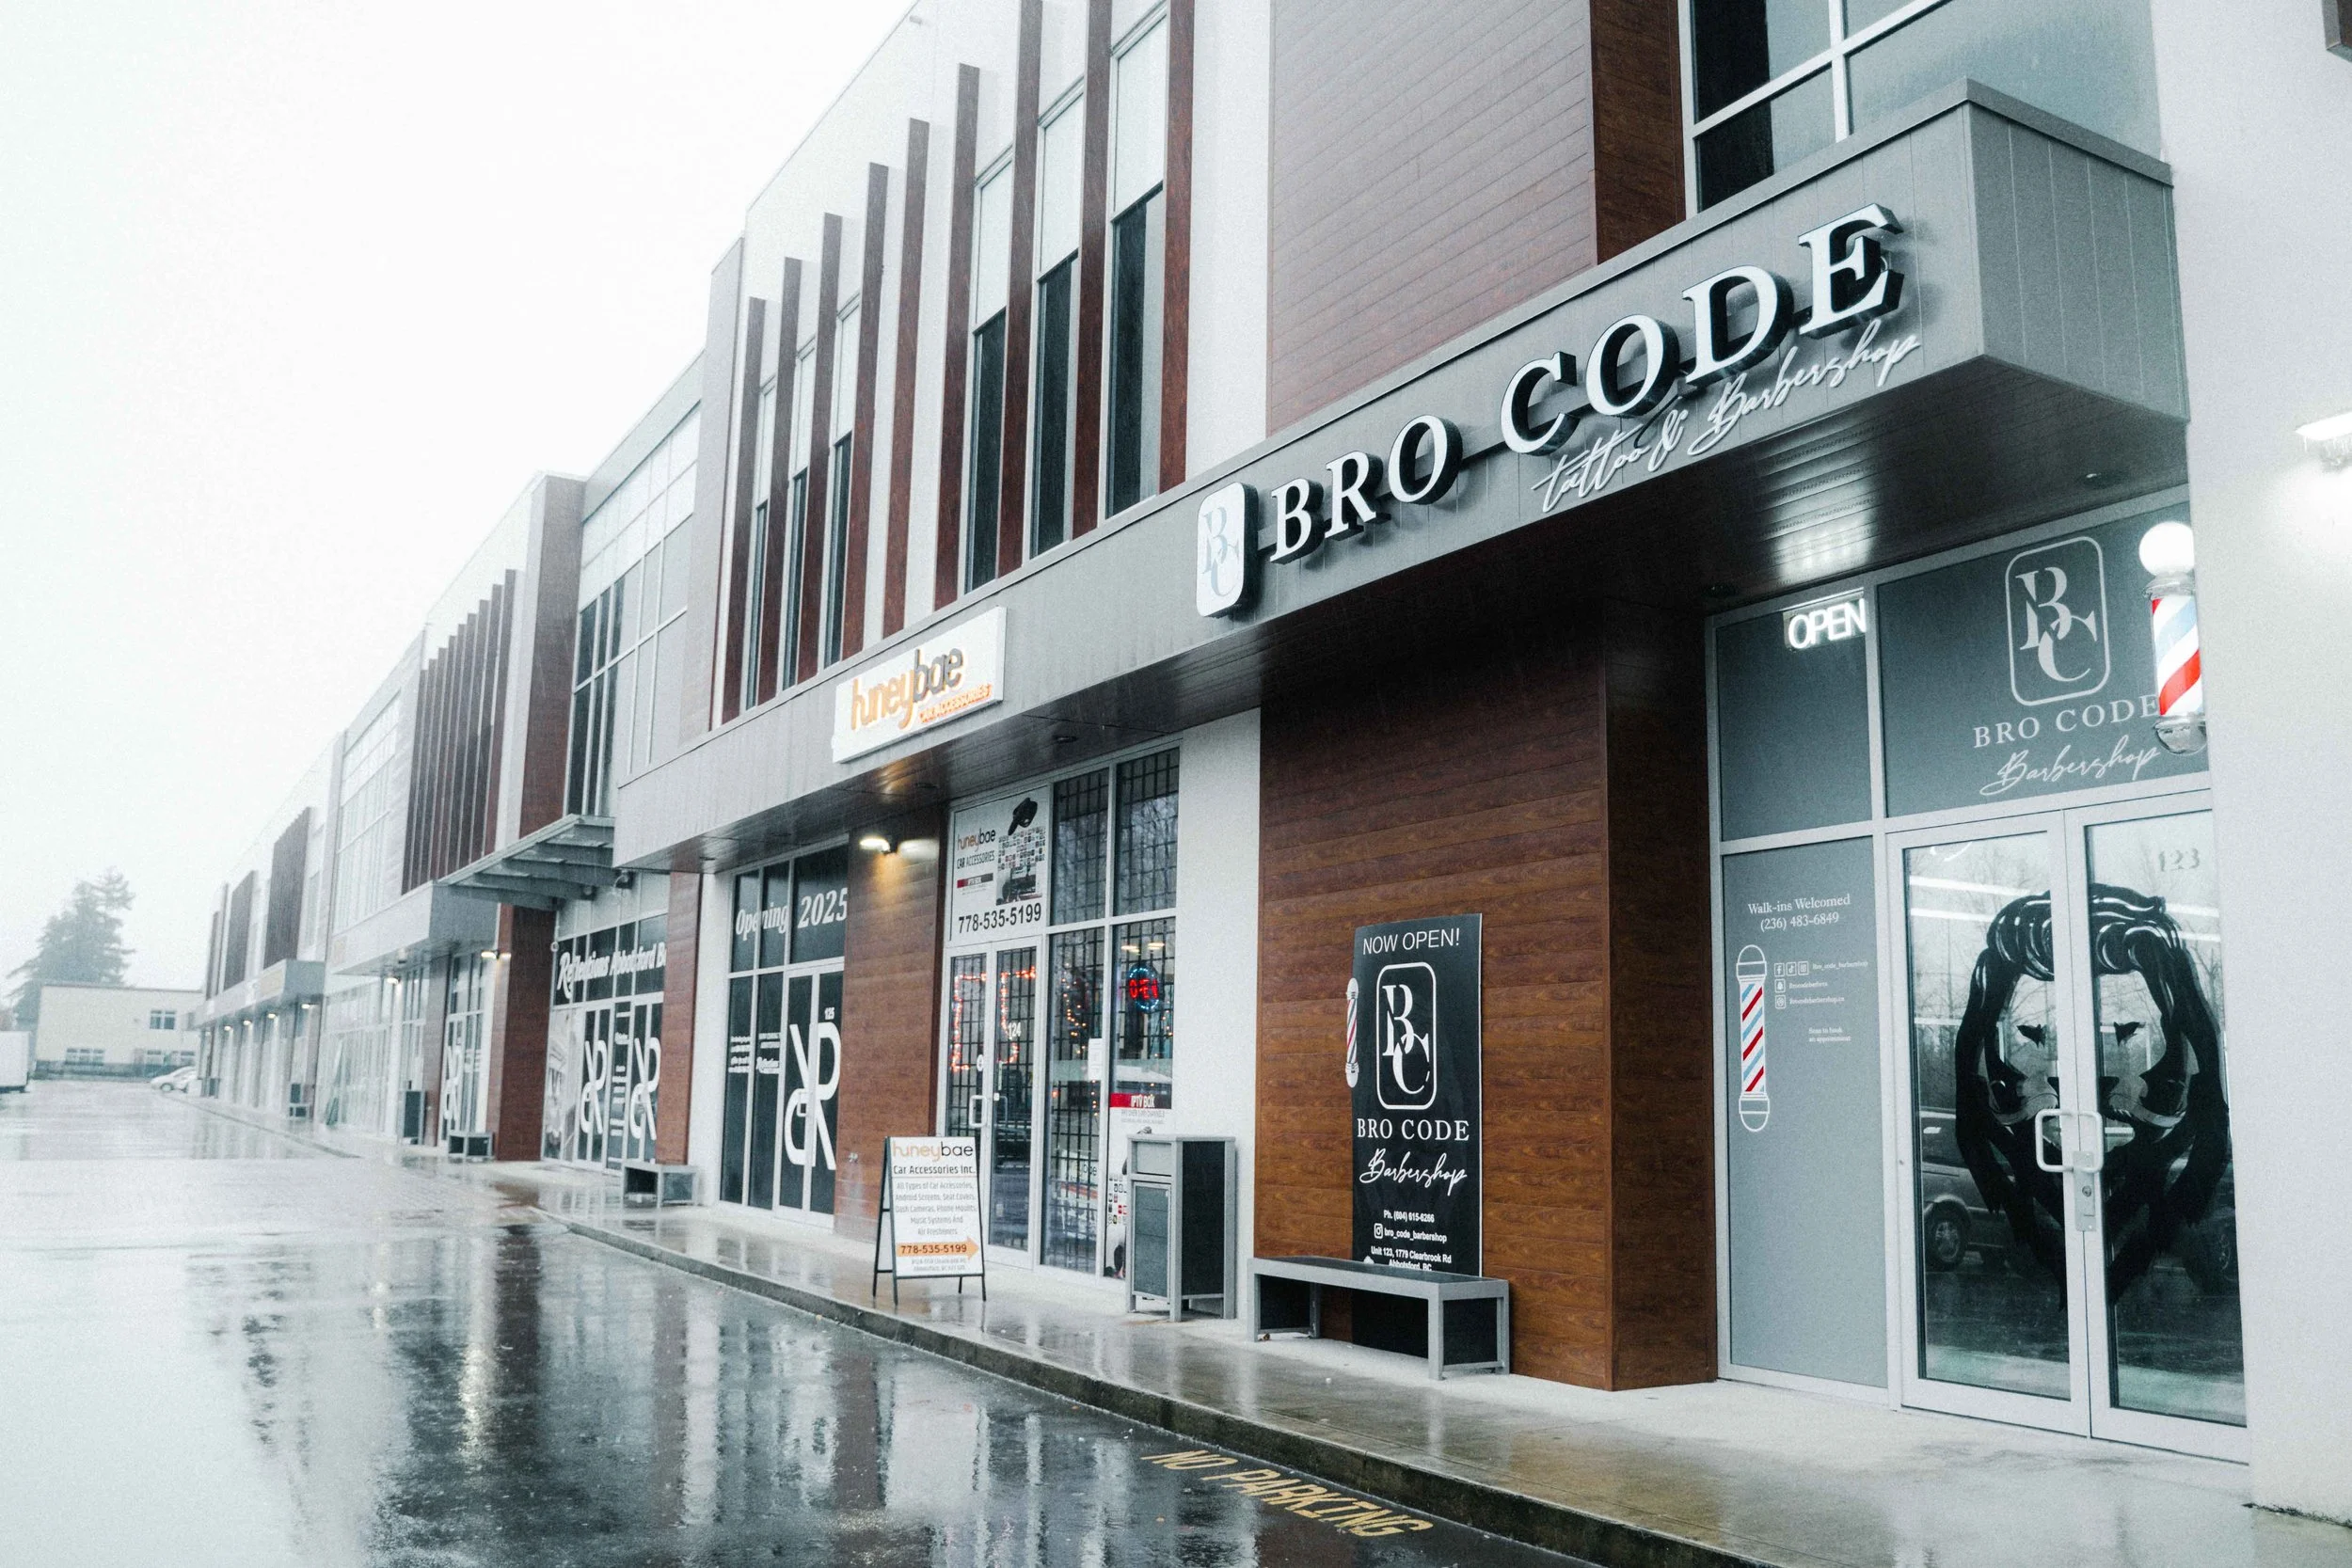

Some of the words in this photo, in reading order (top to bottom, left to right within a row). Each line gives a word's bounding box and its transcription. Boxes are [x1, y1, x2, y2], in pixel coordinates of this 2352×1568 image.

[1270, 414, 1458, 564] BRO
[1501, 203, 1900, 456] CODE
[1648, 409, 1689, 472] &
[1687, 319, 1921, 455] Barbershop
[1788, 597, 1867, 649] OPEN
[1973, 717, 2040, 748] BRO
[2056, 694, 2159, 732] CODE
[1979, 735, 2161, 796] Barbershop
[966, 850, 995, 866] ACCESSORIES
[2158, 847, 2201, 873] 123
[798, 887, 848, 928] 2025
[1748, 901, 1792, 914] Walk-ins
[1794, 893, 1851, 910] Welcomed
[959, 903, 1041, 933] 778-535-5199
[1760, 917, 1787, 932] (236)
[1790, 911, 1839, 927] 483-6849
[1362, 934, 1398, 955] NOW
[1402, 927, 1460, 951] OPEN!
[1009, 1022, 1022, 1037] 124
[1143, 1094, 1155, 1108] BOX
[1357, 1118, 1392, 1139] BRO
[1401, 1119, 1470, 1141] CODE
[893, 1165, 906, 1174] Car
[910, 1165, 959, 1174] Accessories
[961, 1165, 976, 1174] Inc.
[1359, 1148, 1468, 1196] Barbershop
[1383, 1210, 1392, 1219] Ph.
[1384, 1227, 1448, 1243] bro_code_barbershop
[900, 1243, 967, 1254] 778-535-5199
[1371, 1245, 1382, 1256] Unit
[1395, 1249, 1408, 1259] 1779
[1409, 1251, 1441, 1262] Clearbrook
[1442, 1254, 1452, 1264] Rd
[1140, 1449, 1239, 1470] NO
[1200, 1468, 1434, 1537] PARKING
